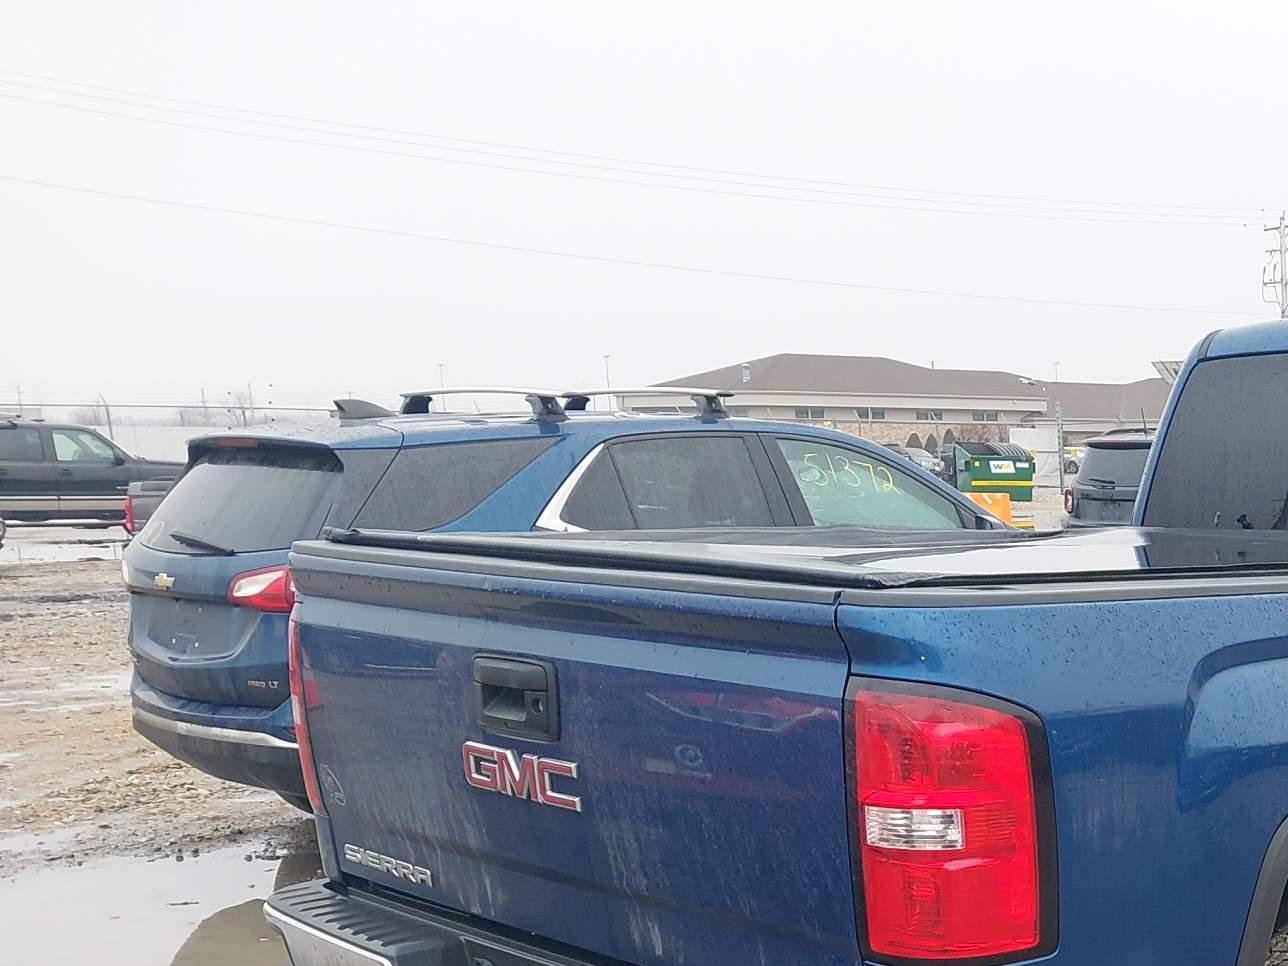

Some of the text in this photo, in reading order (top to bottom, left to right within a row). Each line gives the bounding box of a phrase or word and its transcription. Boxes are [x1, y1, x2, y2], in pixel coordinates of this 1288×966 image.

[803, 453, 903, 495] 51372
[268, 680, 280, 689] LT
[462, 740, 582, 813] GMC
[344, 843, 433, 888] SIERRA
